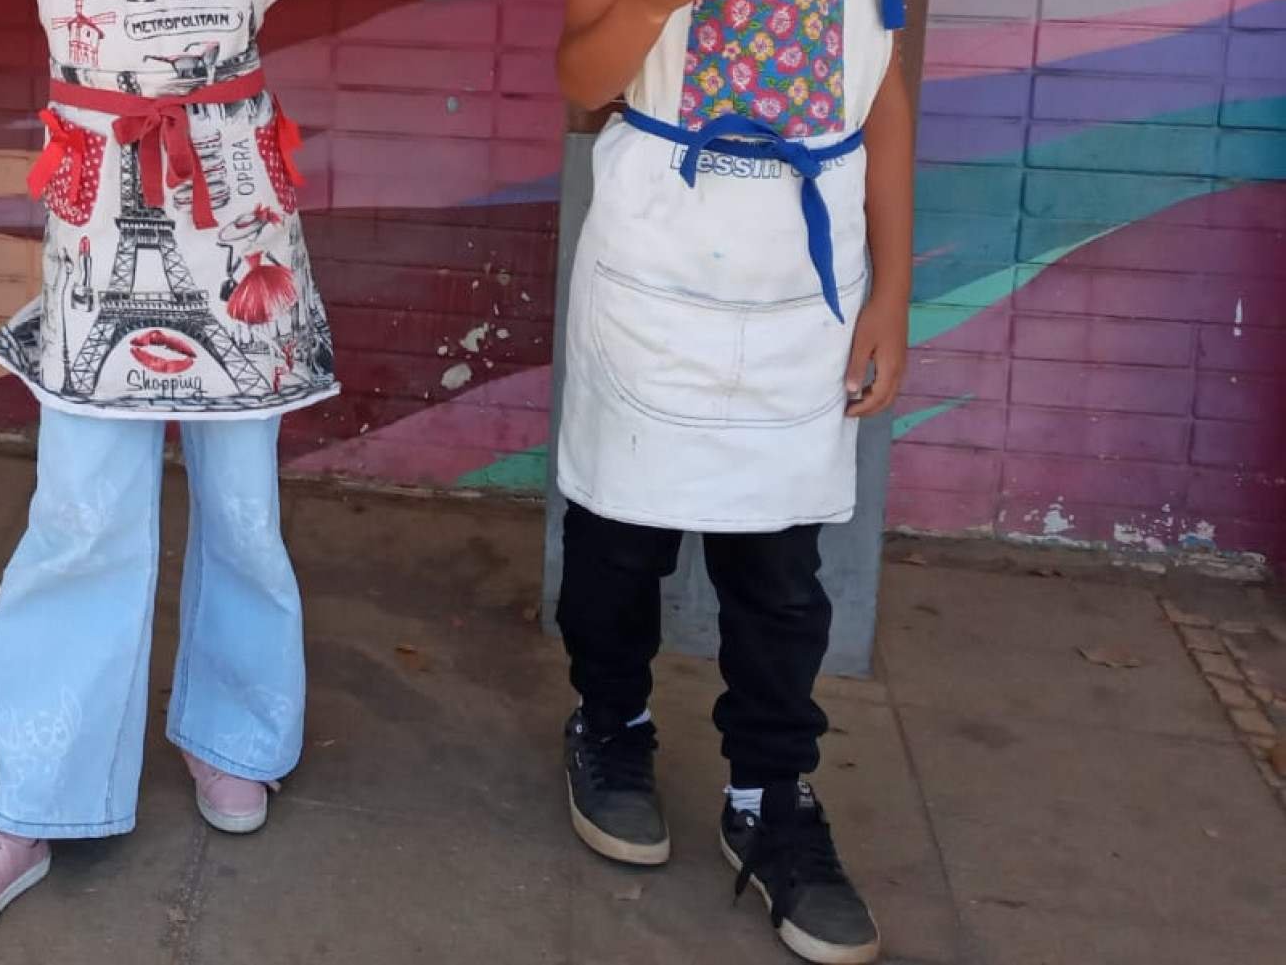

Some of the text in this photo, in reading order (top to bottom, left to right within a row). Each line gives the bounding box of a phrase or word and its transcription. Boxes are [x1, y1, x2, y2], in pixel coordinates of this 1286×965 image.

[131, 13, 230, 34] METROPOLITAIN
[232, 138, 255, 196] OPERA
[126, 368, 209, 403] Shopping
